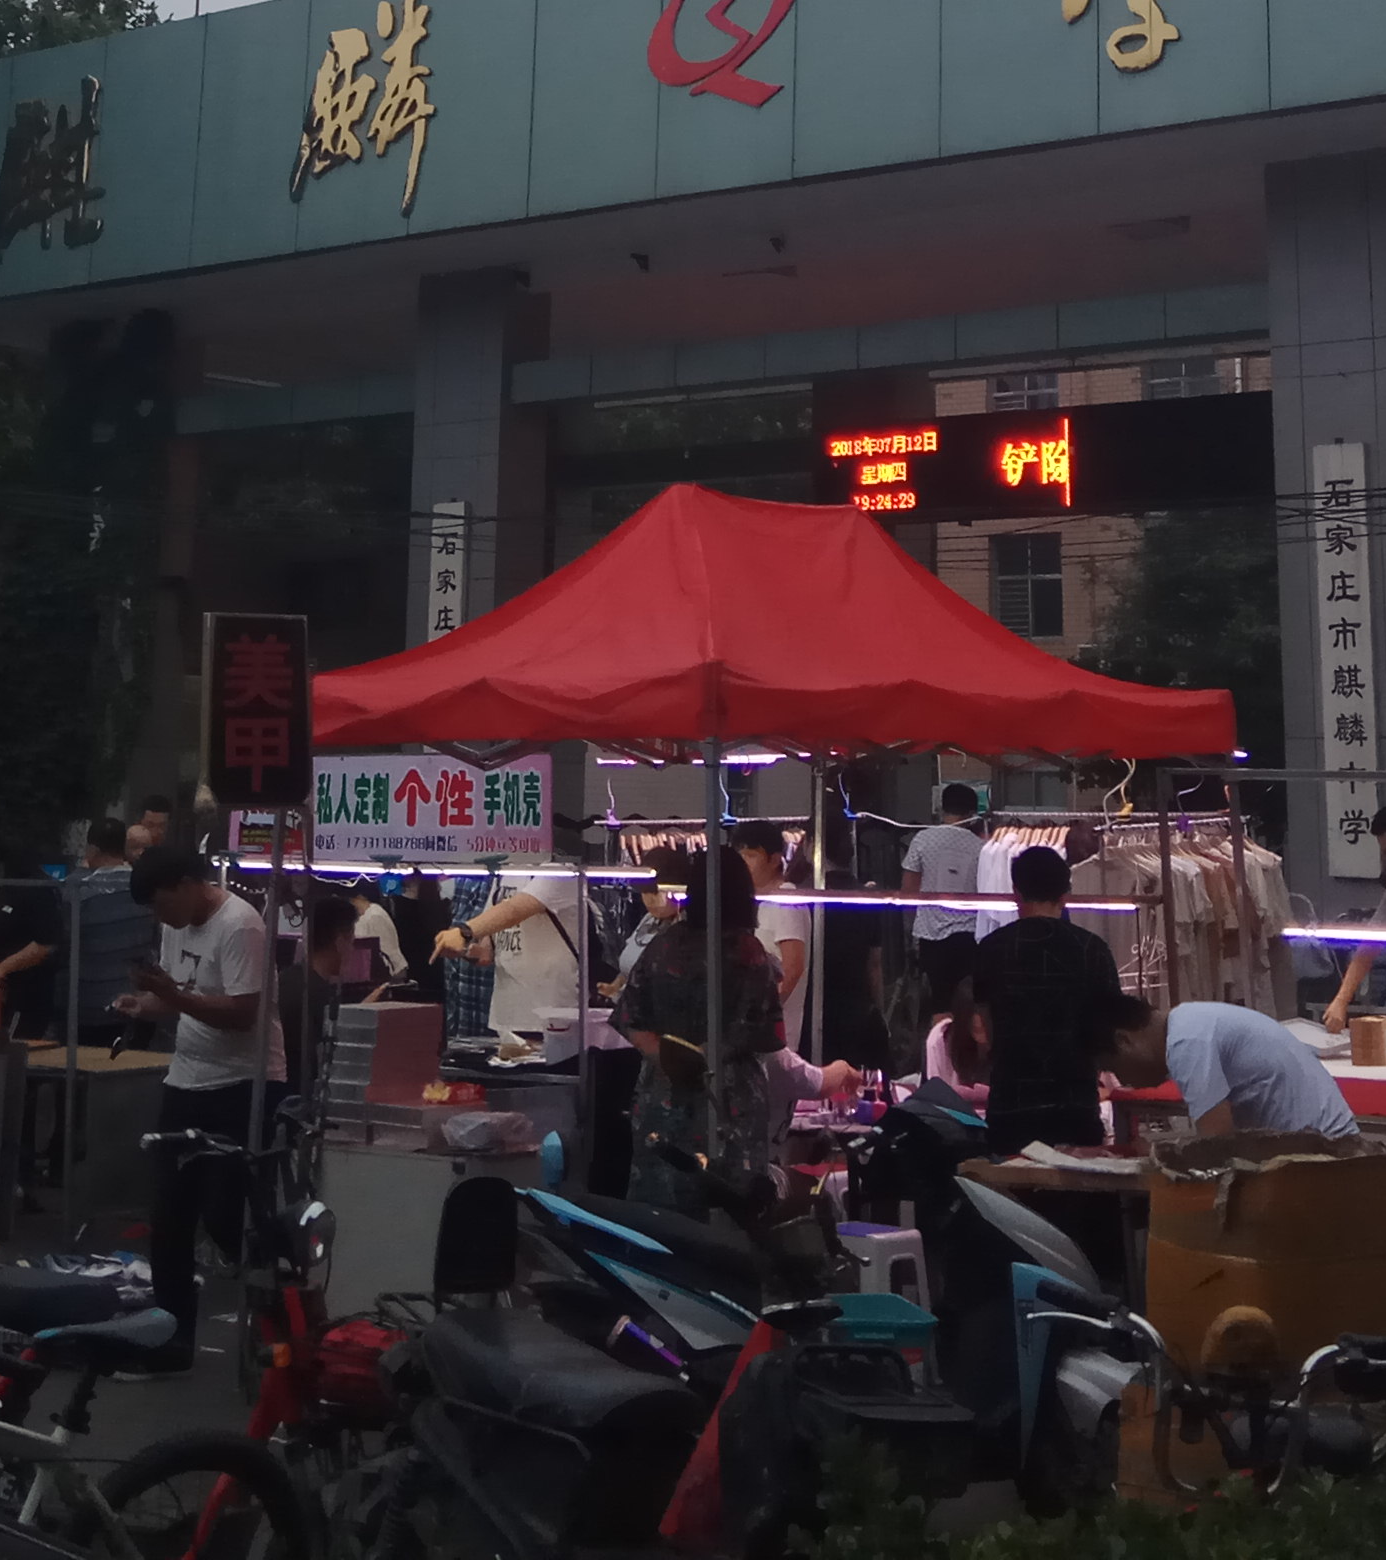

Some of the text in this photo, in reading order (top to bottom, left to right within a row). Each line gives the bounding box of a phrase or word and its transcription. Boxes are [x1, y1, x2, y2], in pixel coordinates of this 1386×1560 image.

[830, 431, 938, 456] 2018年07月12日
[861, 462, 907, 484] 星期四
[434, 532, 458, 631] 石家庄
[223, 633, 294, 793] 美甲
